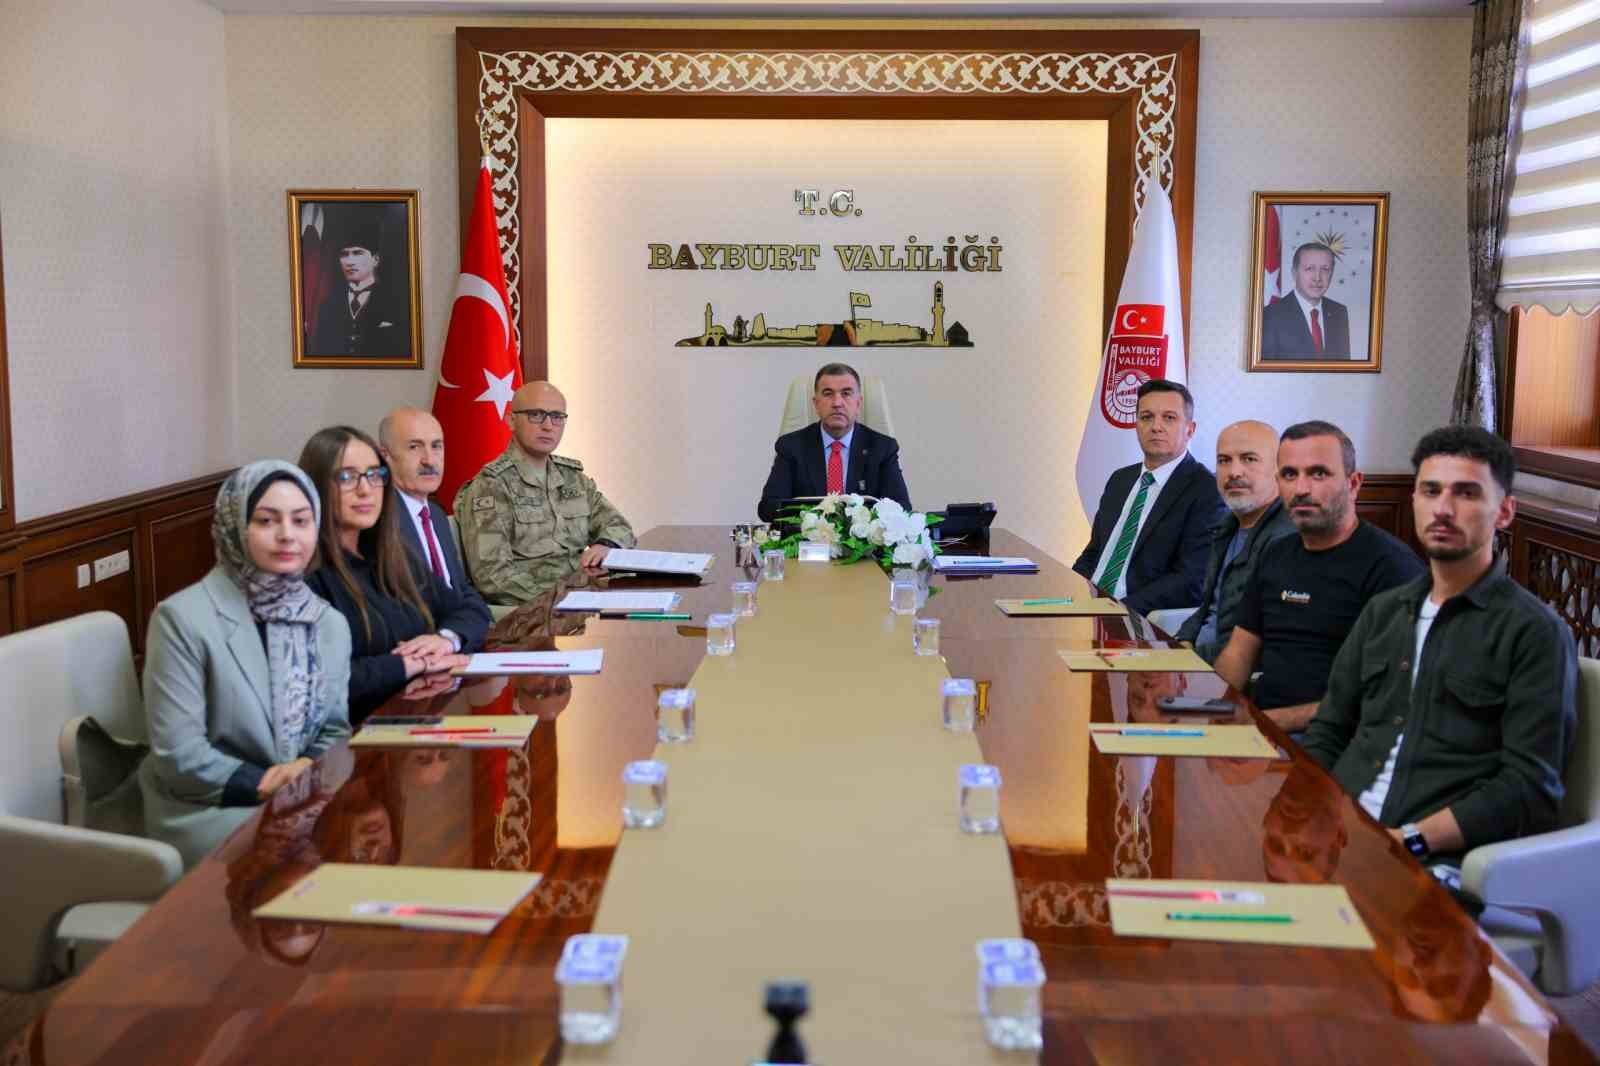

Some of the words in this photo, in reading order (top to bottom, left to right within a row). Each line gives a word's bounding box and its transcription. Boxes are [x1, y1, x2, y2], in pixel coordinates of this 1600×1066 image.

[795, 189, 863, 217] T.C.
[648, 243, 820, 270] BAYBURT
[834, 235, 1002, 271] VALİLİĞİ
[1120, 345, 1161, 355] BAYBURT
[1119, 356, 1160, 366] VALİLİĞİ
